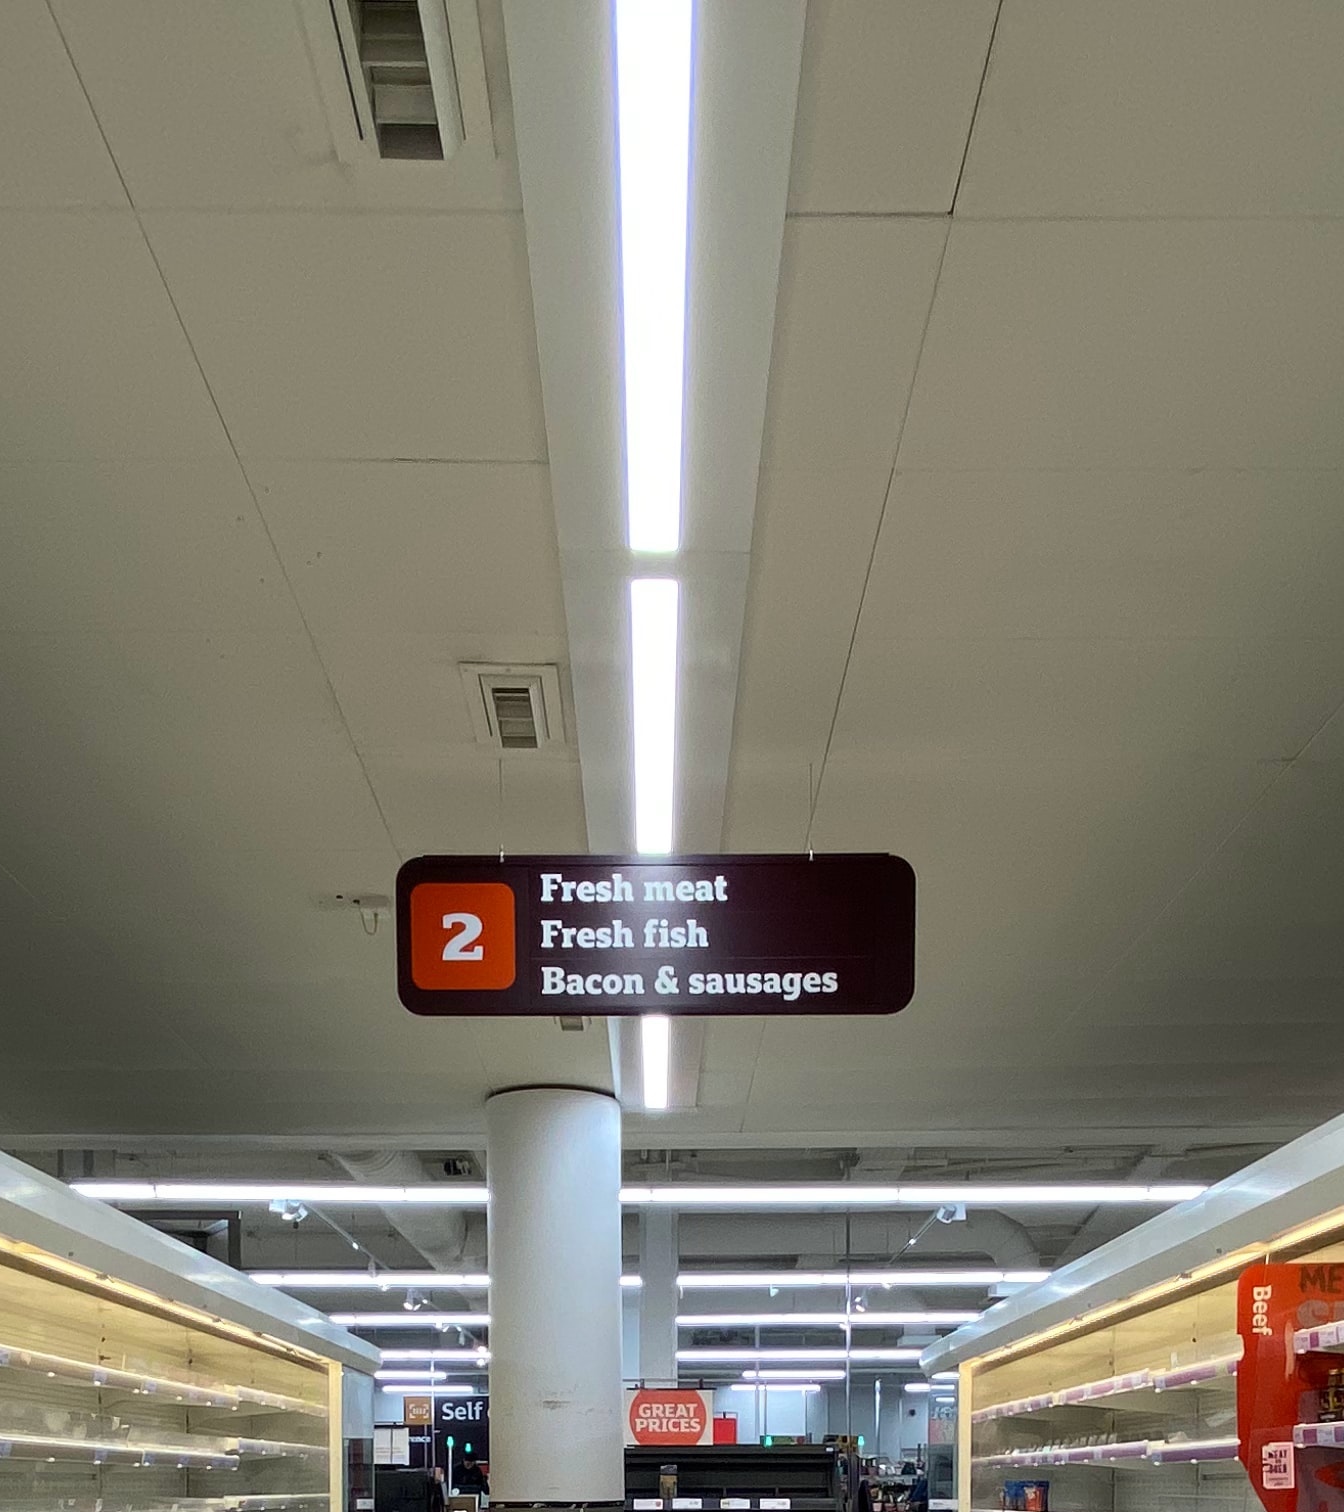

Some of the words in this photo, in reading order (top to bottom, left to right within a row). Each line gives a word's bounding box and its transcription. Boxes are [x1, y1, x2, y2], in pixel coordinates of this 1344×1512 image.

[540, 873, 634, 903] Fresh
[643, 875, 728, 903] meat
[441, 912, 485, 962] 2
[540, 919, 634, 949] Fresh
[643, 919, 709, 949] fish
[540, 965, 644, 996] Bacon
[654, 966, 679, 996] &
[688, 969, 839, 1001] sausages
[1252, 1285, 1273, 1337] Beef
[442, 1401, 484, 1421] Self
[634, 1418, 702, 1433] PRICES
[638, 1403, 699, 1418] GREAT
